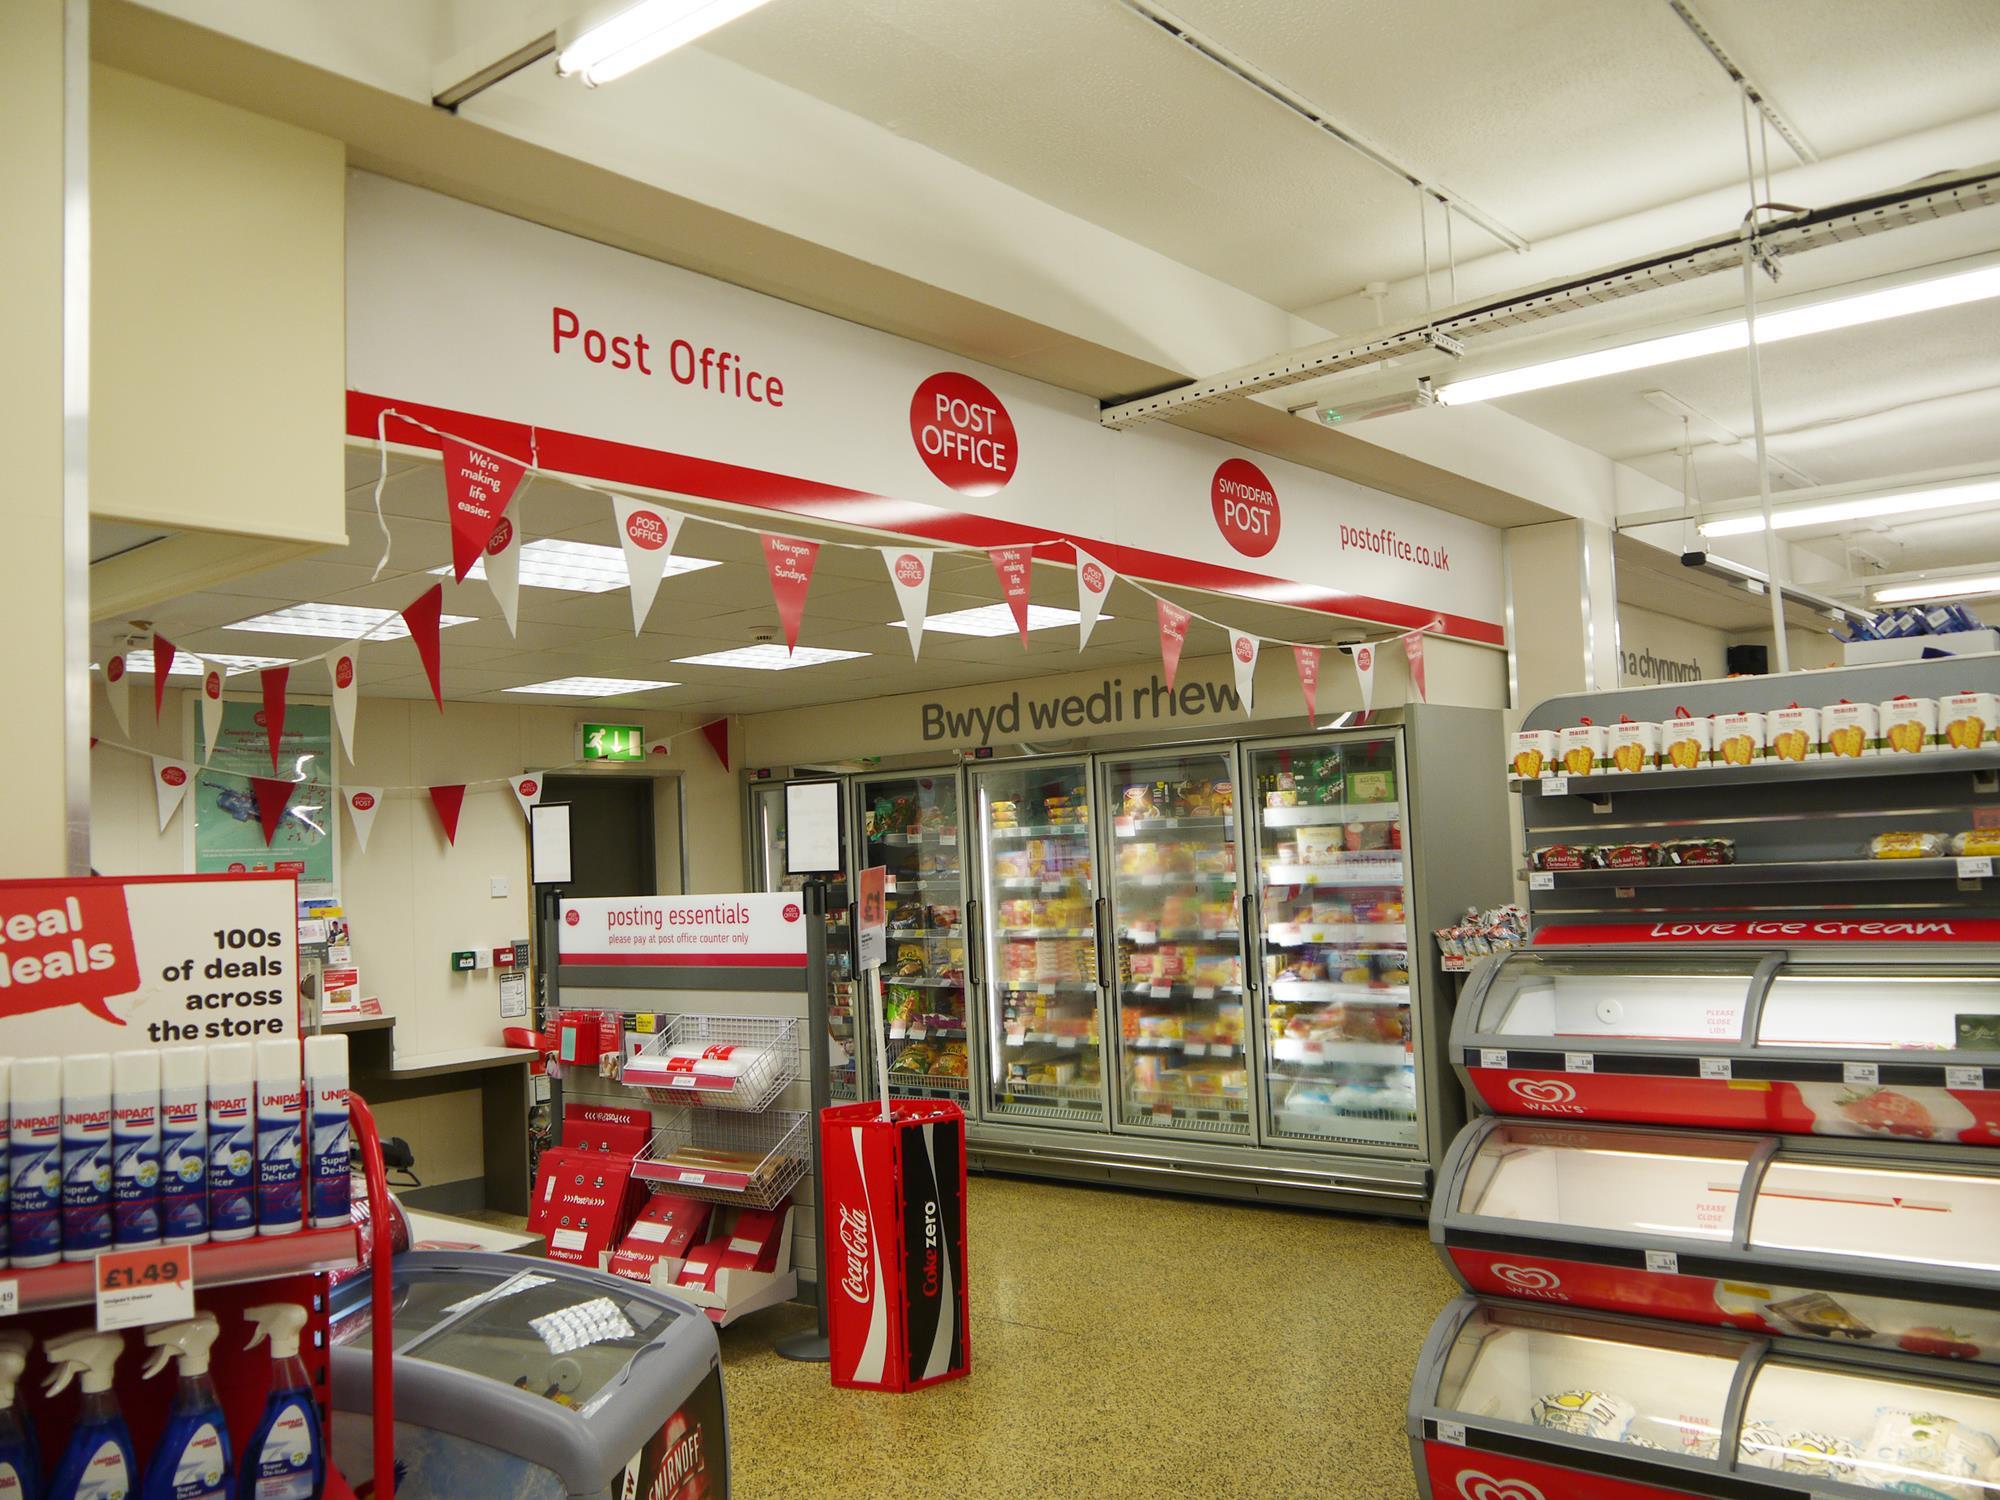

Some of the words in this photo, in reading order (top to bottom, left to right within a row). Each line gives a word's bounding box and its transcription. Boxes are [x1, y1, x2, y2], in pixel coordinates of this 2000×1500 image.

[553, 307, 651, 376] Post
[670, 340, 785, 408] Office
[936, 393, 997, 435] POST
[921, 425, 1008, 472] OFFICE
[469, 450, 500, 473] We're
[461, 468, 501, 493] making
[469, 485, 487, 502] life
[458, 501, 492, 520] easier.
[1224, 499, 1271, 536] POST
[635, 516, 662, 533] POST
[629, 526, 664, 545] OFFICE
[772, 539, 790, 552] Now
[791, 545, 810, 557] open
[1340, 522, 1451, 572] postoffice.co.uk
[785, 557, 796, 566] on
[901, 560, 919, 571] POST
[775, 565, 808, 584] Sundays.
[897, 569, 922, 581] OFFICE
[1083, 572, 1103, 591] OFFICE
[1087, 566, 1102, 580] POST
[1629, 652, 1638, 675] a
[922, 692, 1019, 745] Bwyd
[1032, 679, 1123, 730] wedi
[1133, 675, 1254, 720] rhew
[354, 799, 372, 807] POST
[0, 896, 83, 946] eal
[608, 905, 663, 930] posting
[669, 903, 750, 925] essentials
[783, 911, 799, 919] OFFICE
[1650, 922, 1737, 937] Love
[1746, 921, 1807, 935] ice
[214, 928, 282, 950] 100s
[608, 934, 632, 945] please
[633, 934, 647, 946] pay
[648, 935, 656, 944] at
[658, 934, 675, 945] post
[676, 932, 697, 944] office
[699, 932, 730, 944] counter
[731, 932, 749, 945] only
[162, 960, 194, 982] of
[204, 956, 283, 980] deals
[186, 988, 283, 1011] across
[1706, 1009, 1735, 1017] PLEASE
[1706, 1017, 1731, 1026] CLOSE
[148, 1020, 199, 1042] the
[205, 1015, 284, 1039] store
[1709, 1026, 1727, 1035] LIDS
[207, 1097, 247, 1112] NIPART
[262, 1092, 301, 1107] UNIPAR
[1522, 1101, 1585, 1114] WALL'S
[12, 1114, 60, 1130] UNIPART
[63, 1110, 110, 1125] UNIPART
[112, 1106, 155, 1121] NIPART
[261, 1162, 291, 1173] Super
[320, 1156, 348, 1167] Super
[209, 1170, 226, 1179] per
[261, 1171, 297, 1182] De-Icer
[115, 1180, 133, 1190] per
[1696, 1203, 1727, 1212] PLEASE
[924, 1201, 937, 1249] zero
[1697, 1213, 1723, 1222] CLOSE
[105, 1261, 179, 1289] £1.49
[1505, 1284, 1569, 1301] WALL'S
